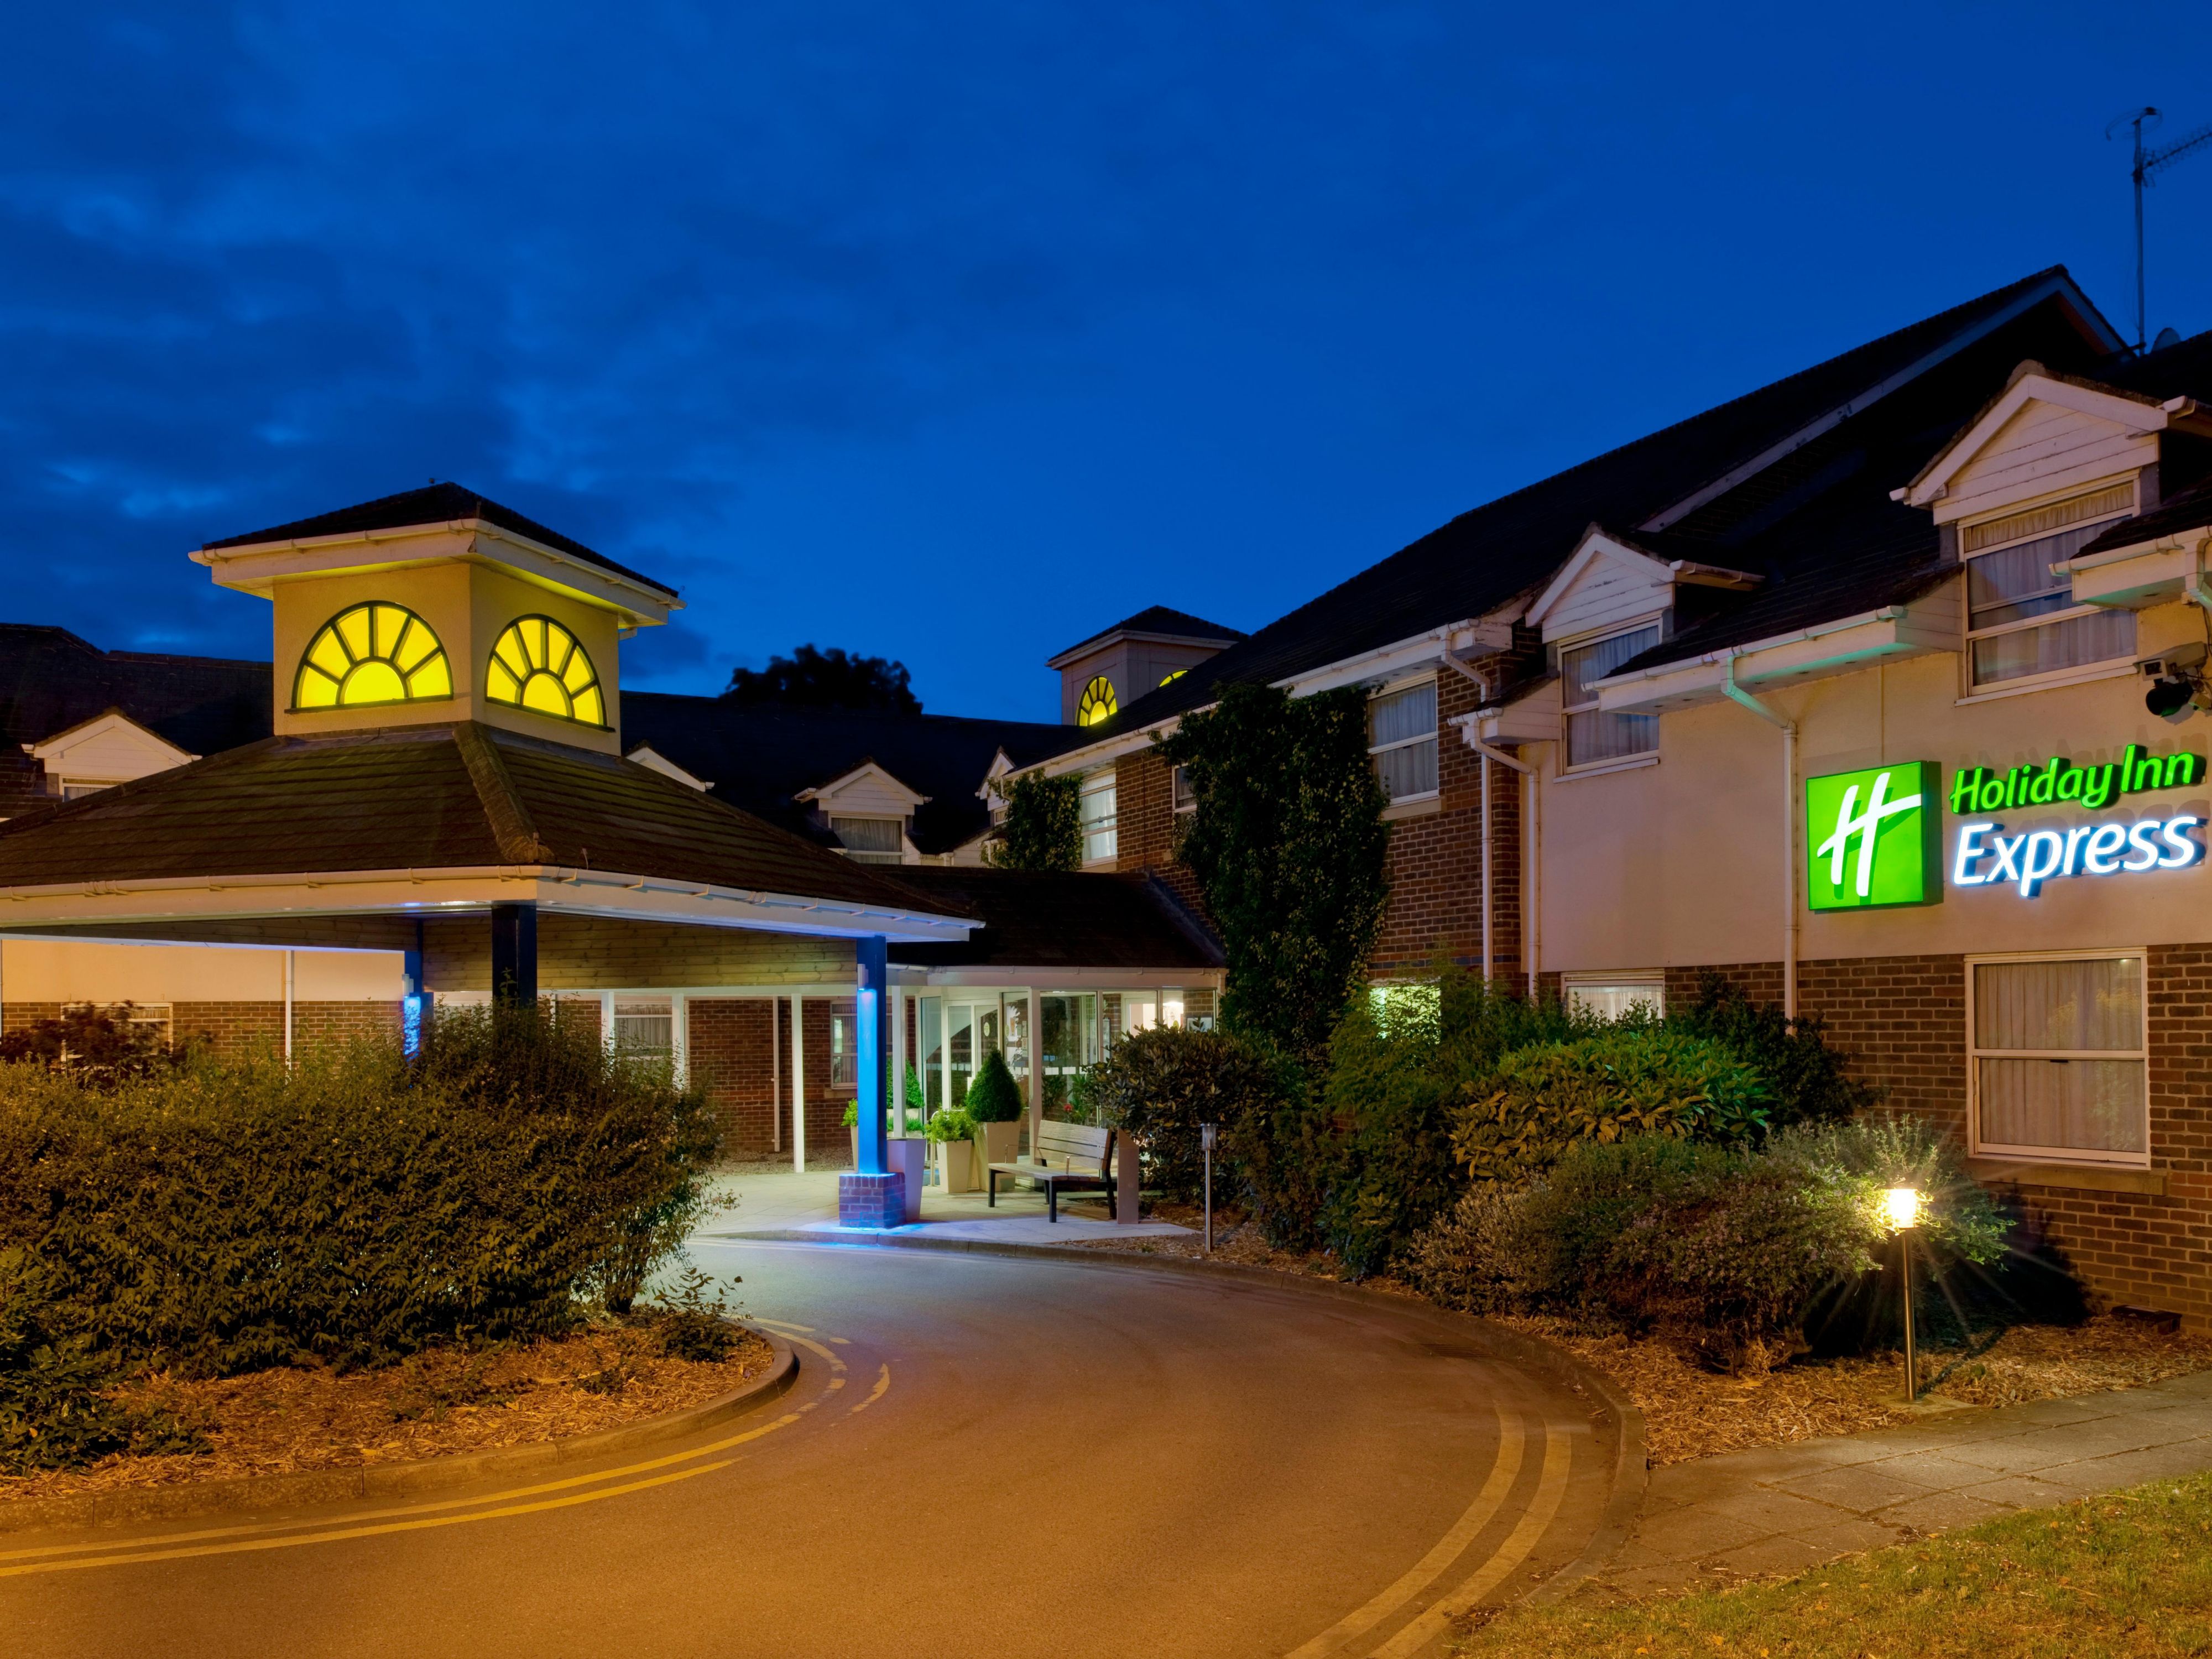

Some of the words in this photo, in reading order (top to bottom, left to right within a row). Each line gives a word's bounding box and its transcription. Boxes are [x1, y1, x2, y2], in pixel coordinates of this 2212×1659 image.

[1950, 757, 2114, 813] Holiday
[2120, 744, 2194, 792] Inn
[1953, 816, 2197, 898] Express
